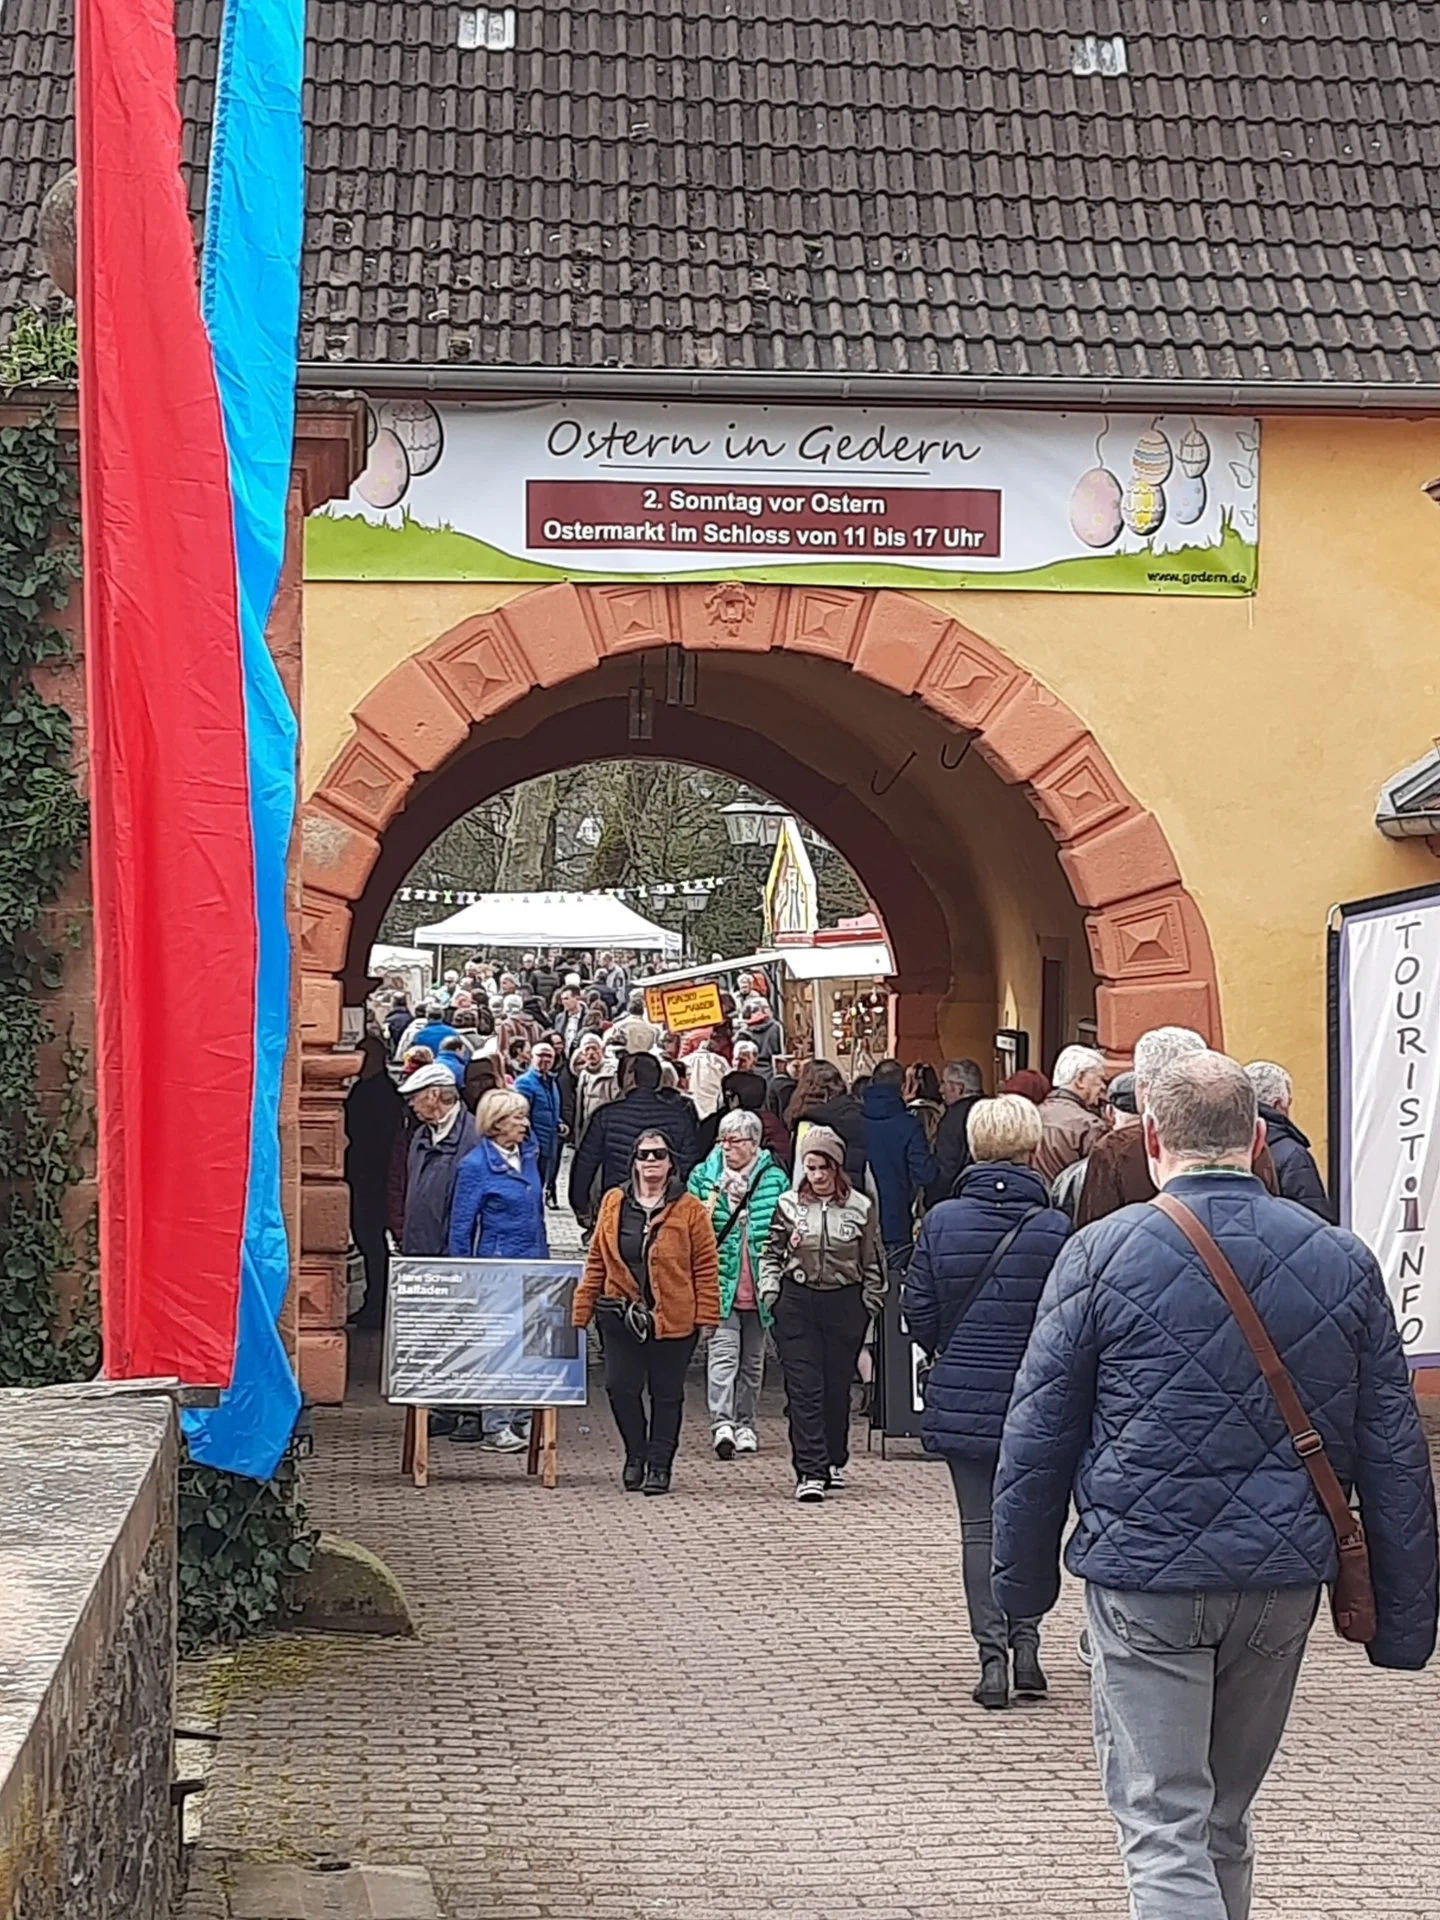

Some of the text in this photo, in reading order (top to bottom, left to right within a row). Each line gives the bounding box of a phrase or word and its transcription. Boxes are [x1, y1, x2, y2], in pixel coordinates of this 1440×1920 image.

[547, 420, 981, 466] Ostern in Gedern
[643, 489, 886, 516] 2. Sonntag vor Ostern
[543, 520, 985, 548] Ostermarkt im Schloss von 11 bis 17 Uhr
[1394, 919, 1426, 1162] TOURIST
